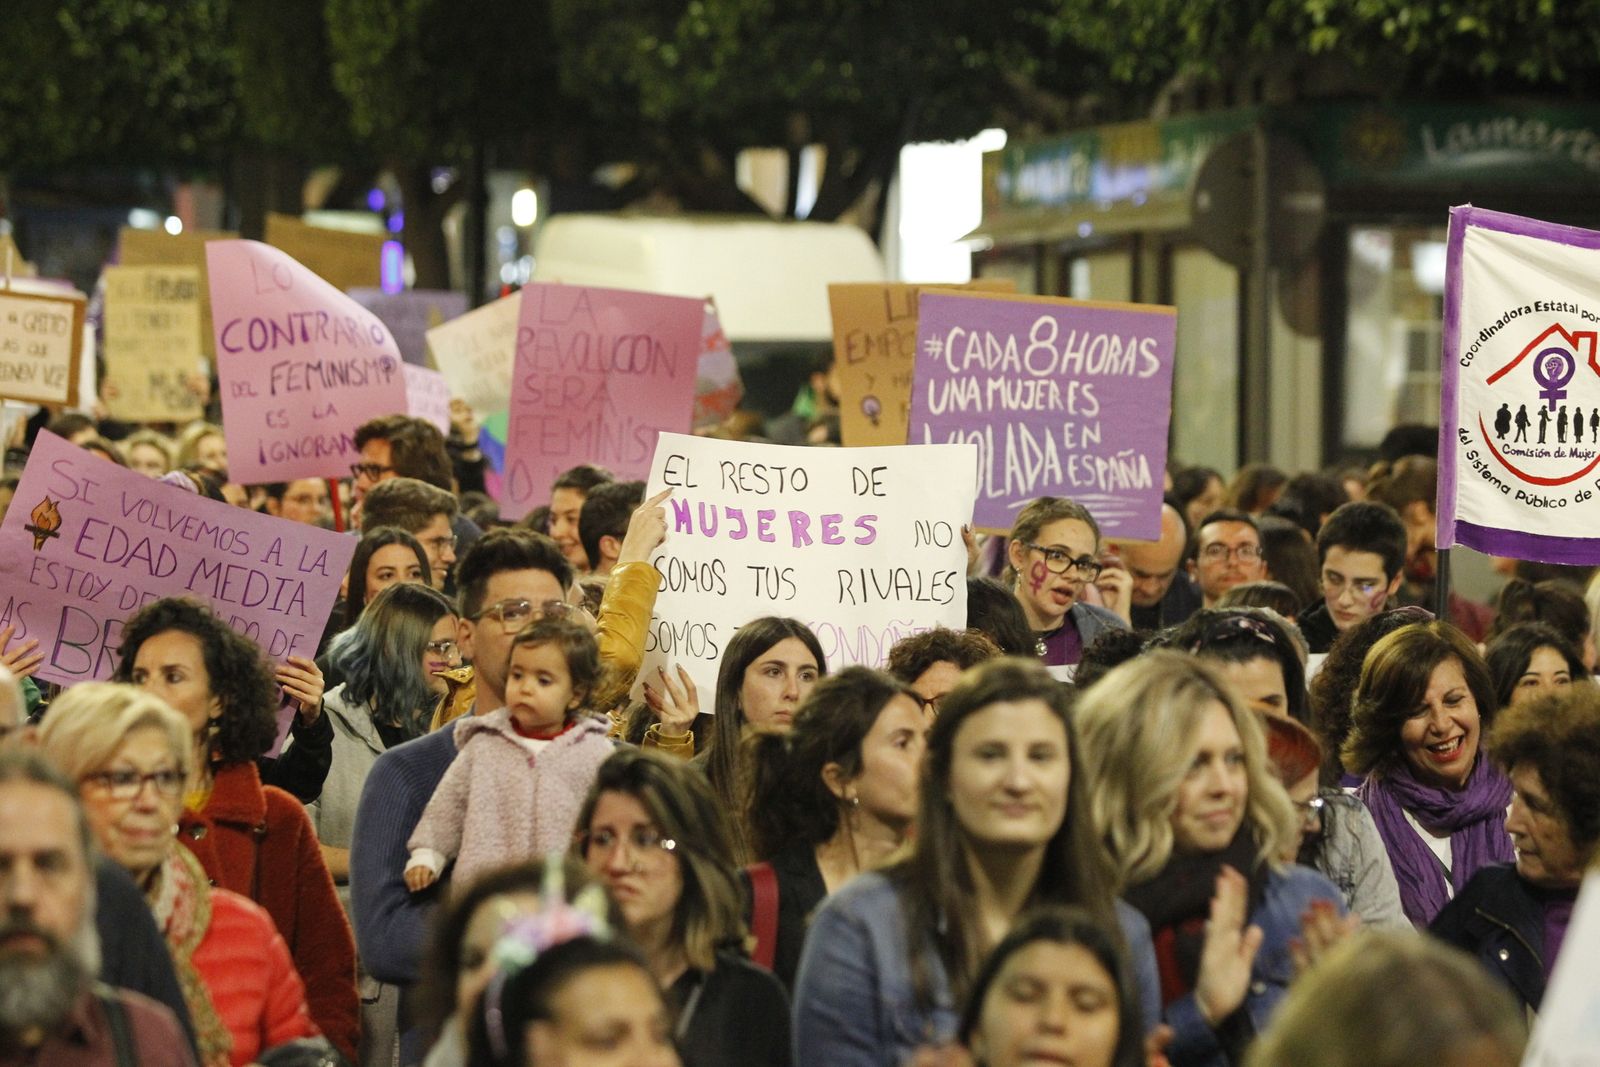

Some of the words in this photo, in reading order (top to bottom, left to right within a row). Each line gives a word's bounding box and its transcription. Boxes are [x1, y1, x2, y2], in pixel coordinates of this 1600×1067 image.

[252, 258, 294, 296] LO
[540, 285, 599, 330] LA
[1459, 305, 1532, 368] Coordinadora
[1534, 300, 1578, 314] Estatal
[266, 409, 290, 429] ES
[312, 402, 339, 420] LA
[514, 412, 669, 464] FEMINIST
[1063, 421, 1102, 450] EN
[1458, 427, 1473, 446] del
[258, 431, 360, 465] IGNORAN
[923, 422, 1064, 499] OLADA
[1067, 448, 1153, 493] ESPAÑA
[1501, 443, 1552, 459] Comisión
[1553, 446, 1567, 459] de
[1568, 447, 1597, 462] Mujer
[663, 454, 698, 488] EL
[719, 460, 809, 496] RESTO
[851, 465, 888, 497] DE
[1465, 449, 1512, 495] Sistema
[49, 458, 101, 506] SI
[120, 491, 250, 556] VOLVEMOS
[259, 536, 284, 567] A
[297, 544, 330, 577] LA
[1573, 490, 1593, 504] de
[671, 497, 879, 549] MUJERES
[914, 519, 954, 548] NO
[29, 555, 113, 604] ESTOY
[75, 517, 178, 579] EDAD
[185, 557, 309, 618] MEDIA
[653, 555, 728, 596] SOMOS
[746, 565, 797, 601] TUS
[837, 567, 958, 606] RIVALES
[0, 596, 33, 640] AS
[643, 616, 719, 661] SOMOS
